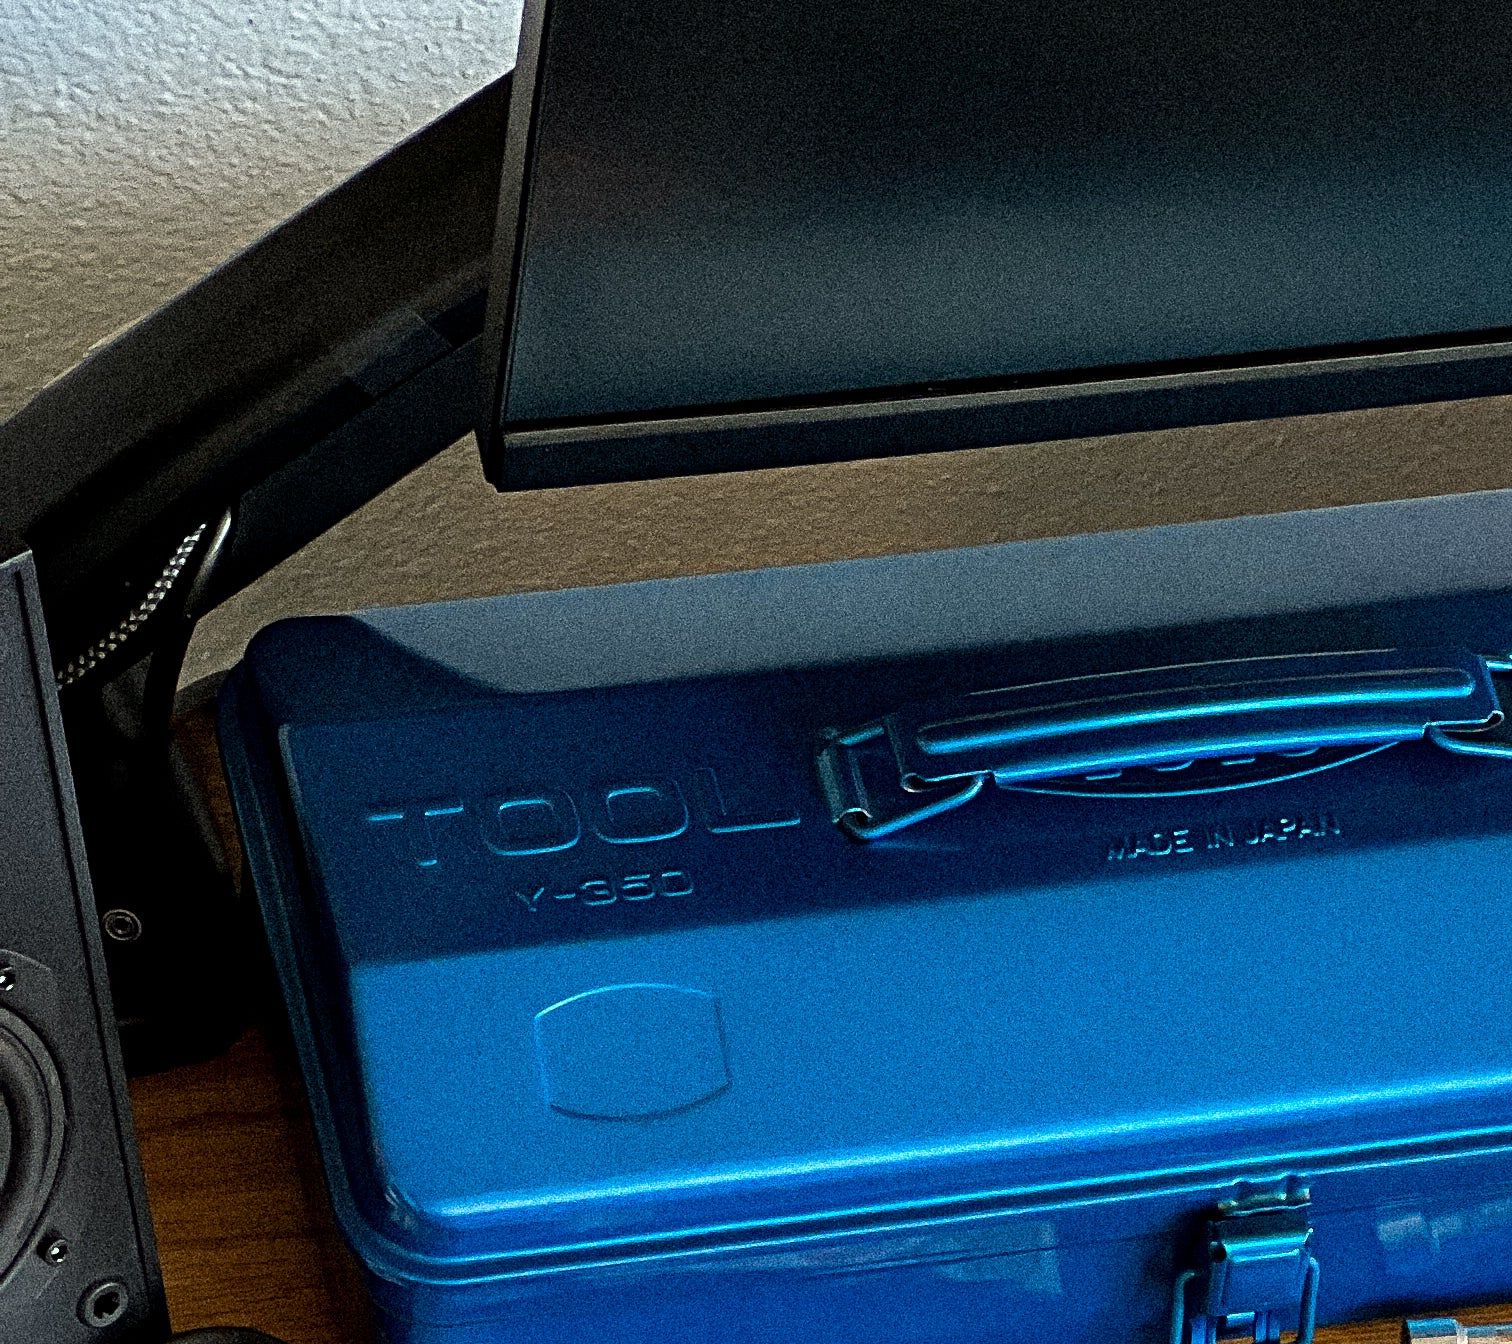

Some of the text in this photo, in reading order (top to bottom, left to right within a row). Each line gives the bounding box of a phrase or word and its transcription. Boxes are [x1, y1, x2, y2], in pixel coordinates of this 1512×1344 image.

[364, 764, 802, 870] TOOL
[1107, 814, 1342, 862] MADE IN JAPAN
[514, 868, 696, 914] Y-350
